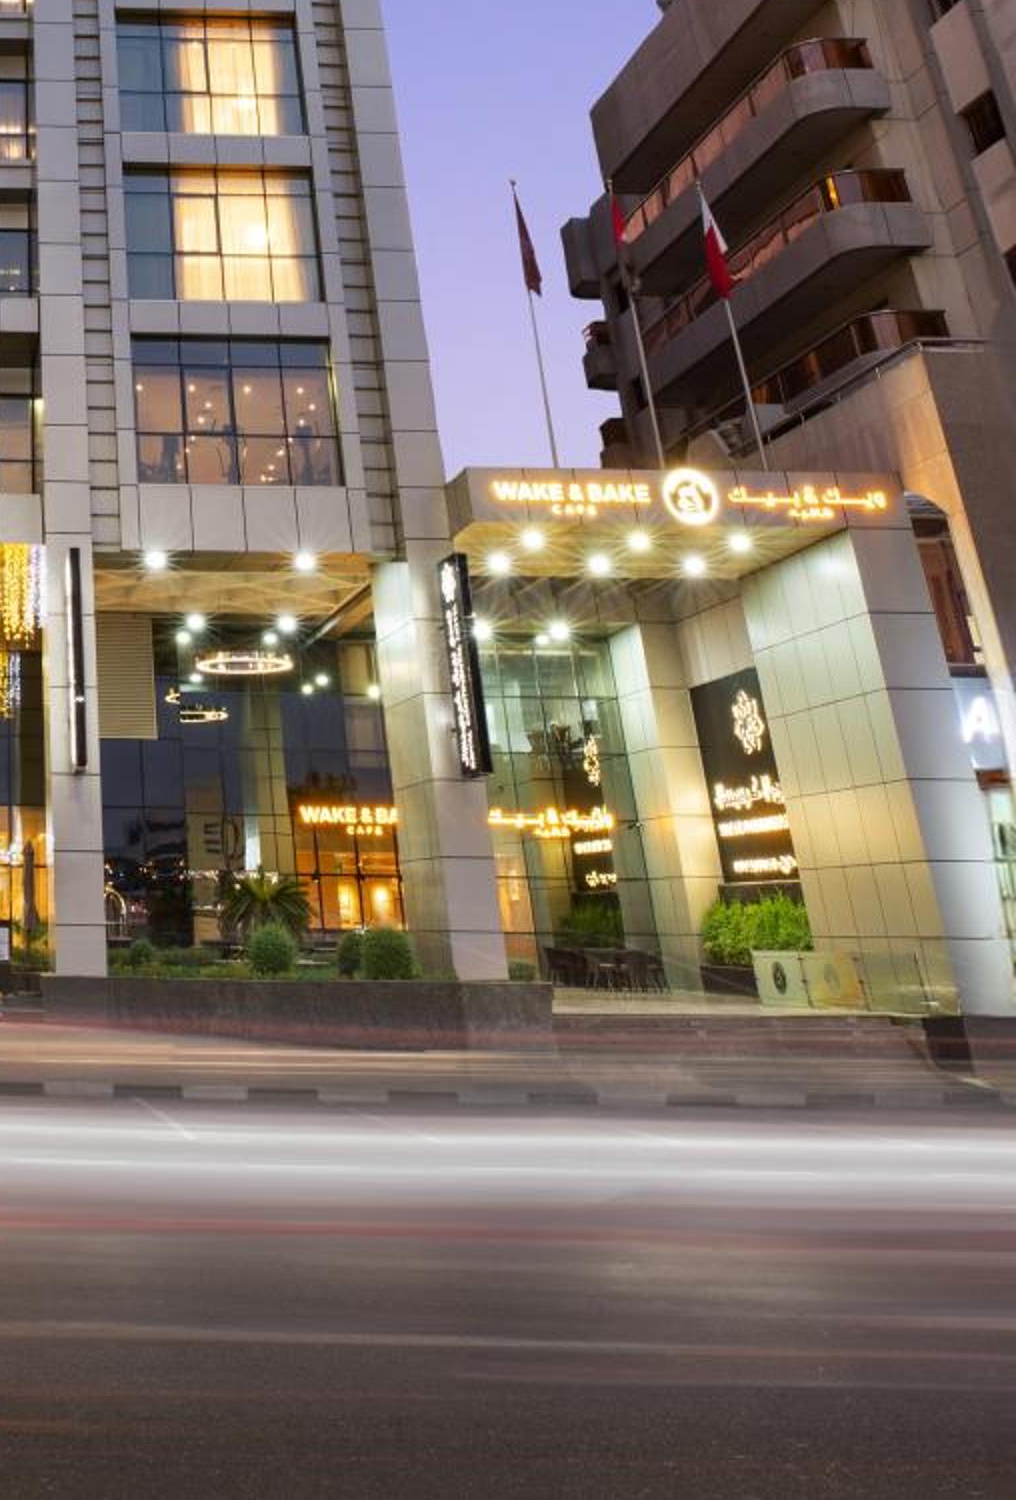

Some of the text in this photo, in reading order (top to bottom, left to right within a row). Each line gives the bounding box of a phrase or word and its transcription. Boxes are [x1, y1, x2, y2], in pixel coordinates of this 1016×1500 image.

[492, 481, 651, 504] WAKE & BAKE
[299, 805, 398, 824] WAKE & BA
